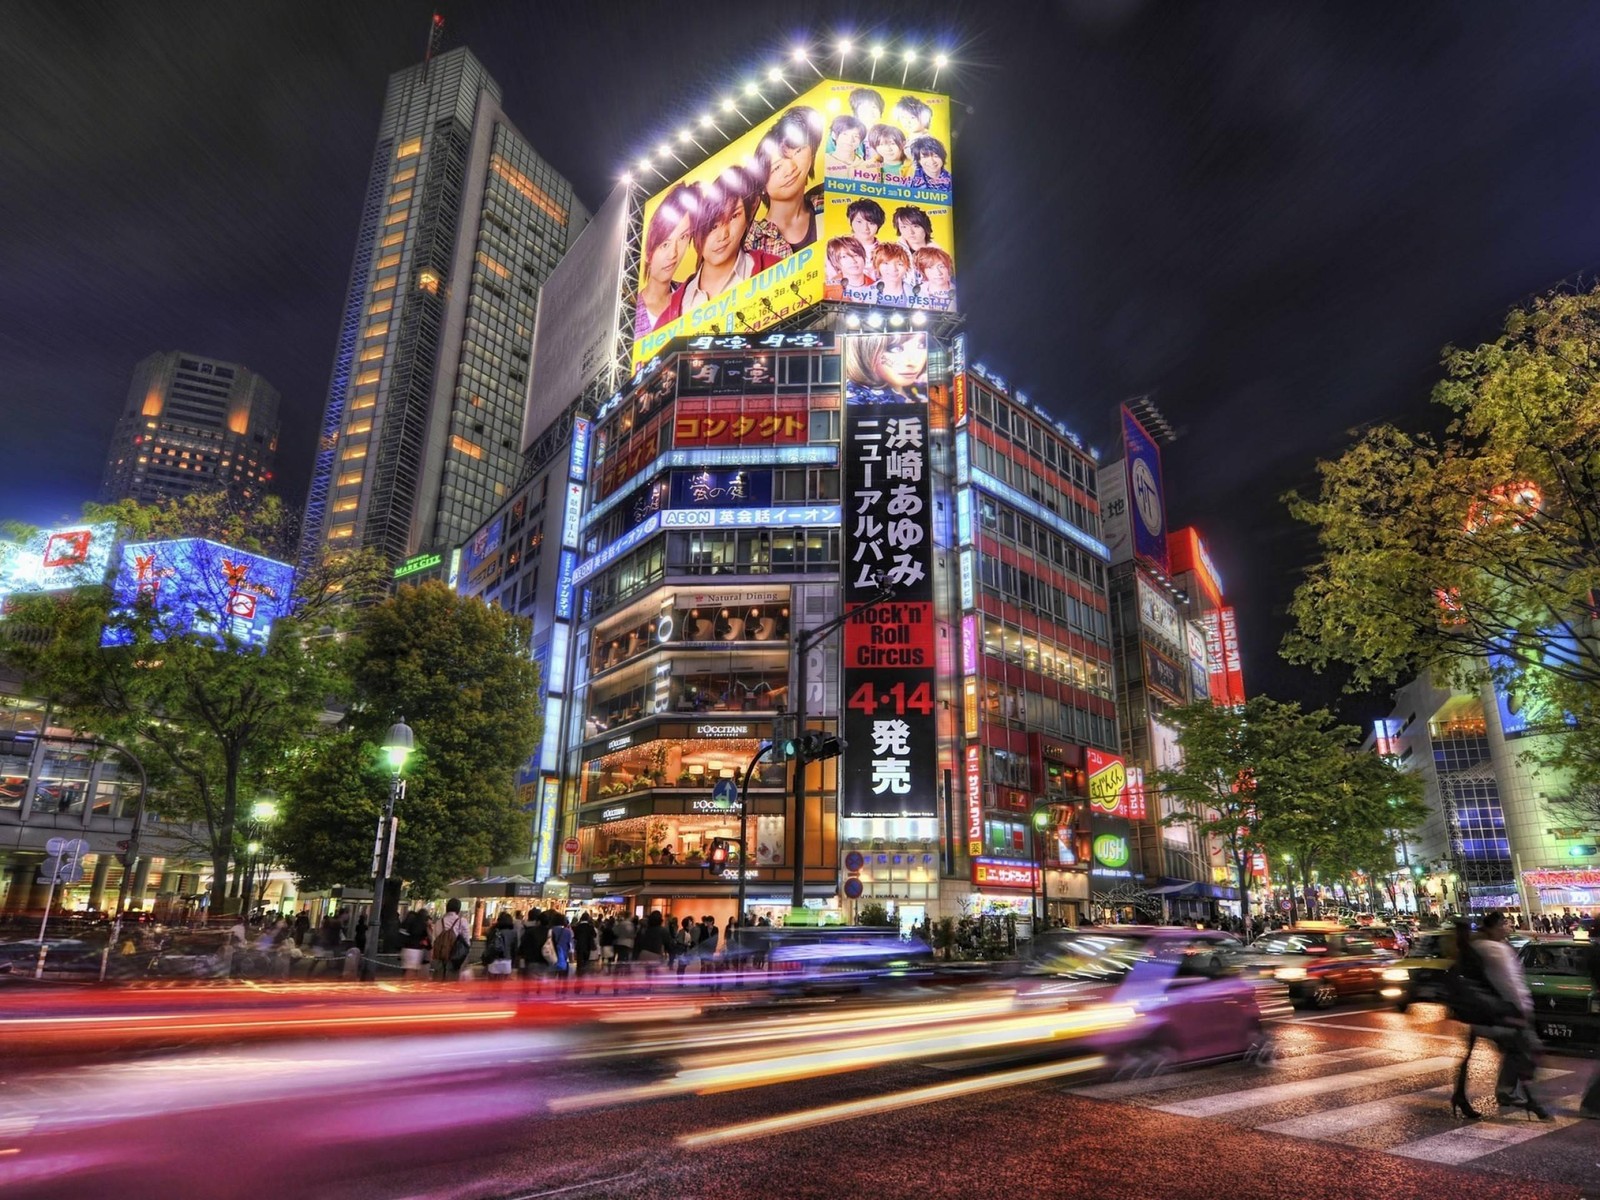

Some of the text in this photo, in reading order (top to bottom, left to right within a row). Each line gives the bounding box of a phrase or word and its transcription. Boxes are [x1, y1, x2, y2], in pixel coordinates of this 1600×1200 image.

[854, 169, 881, 182] Hey!
[885, 173, 911, 185] Say!
[828, 180, 856, 191] Hey!
[860, 184, 886, 196] Say!
[914, 191, 948, 202] JUMP
[641, 248, 813, 354] Hey! Say! JUMP
[843, 289, 872, 301] Hey!
[876, 292, 904, 304] Say!
[676, 414, 807, 439] コンタクト
[853, 420, 884, 588] ニューアルバム
[885, 417, 926, 587] 浜崎あゆみ
[666, 511, 710, 524] AEON
[719, 509, 837, 524] 英会話イーオン
[394, 554, 441, 575] MARK CITY
[707, 591, 778, 602] Natural Dining
[851, 604, 928, 624] Rock'n'
[871, 625, 910, 645] Roll
[857, 646, 924, 666] Circus
[697, 725, 748, 734] L'OCCITANE
[871, 719, 911, 794] 発売
[1091, 768, 1123, 798] むじんくん
[693, 800, 742, 810] L'OCCANE
[1097, 837, 1126, 860] LUSH
